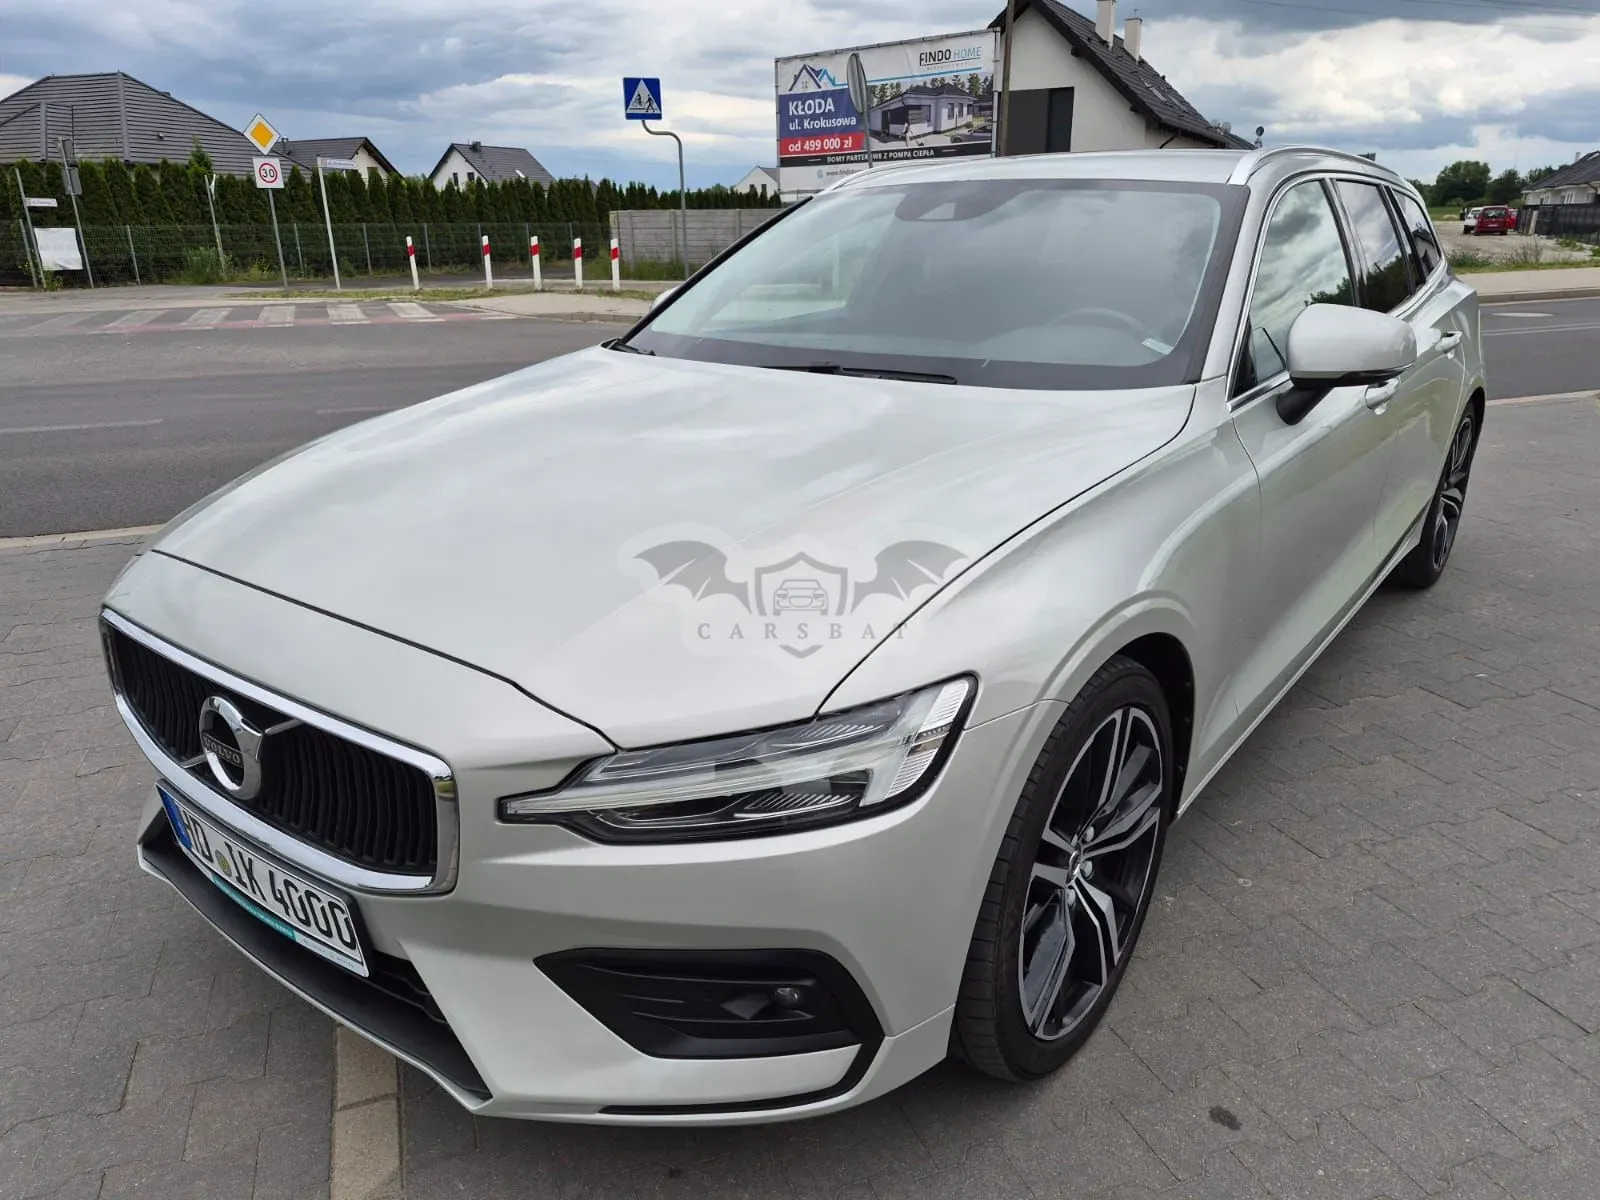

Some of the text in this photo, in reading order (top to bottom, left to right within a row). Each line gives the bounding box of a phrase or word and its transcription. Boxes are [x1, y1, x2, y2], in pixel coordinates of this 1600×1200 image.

[919, 49, 952, 66] FINDO
[953, 46, 982, 60] HOME
[788, 97, 835, 116] KŁODA
[789, 116, 857, 131] ul. Krokusowa
[788, 136, 853, 152] od 499 000 zł
[826, 155, 845, 163] DOMY
[846, 153, 883, 163] PARTERWE
[262, 168, 275, 178] 30
[203, 736, 241, 764] VOLVO
[268, 869, 358, 951] 4000
